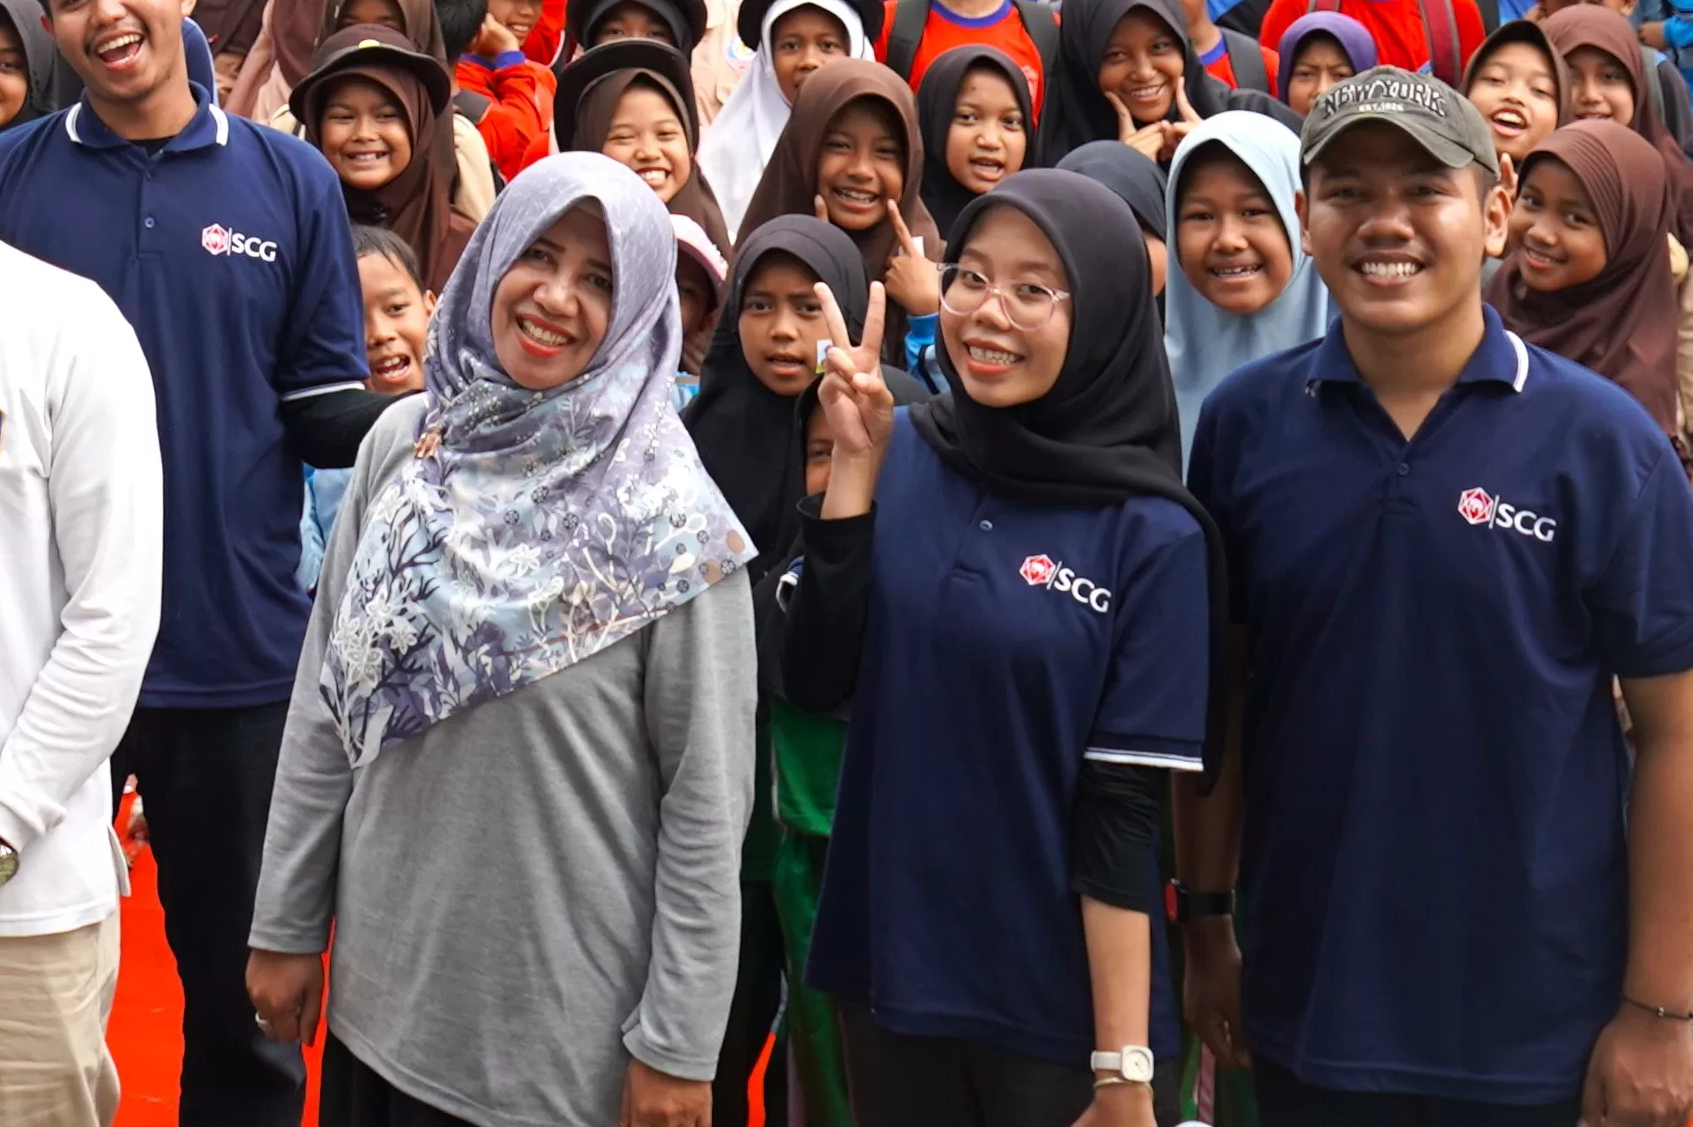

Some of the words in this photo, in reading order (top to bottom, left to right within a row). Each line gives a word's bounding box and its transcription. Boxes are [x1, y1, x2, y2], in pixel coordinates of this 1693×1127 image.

[1322, 83, 1375, 120] NEW
[1377, 80, 1448, 118] YORK
[231, 232, 278, 262] SCG
[1494, 502, 1557, 542] SCG
[1053, 567, 1112, 613] SCG
